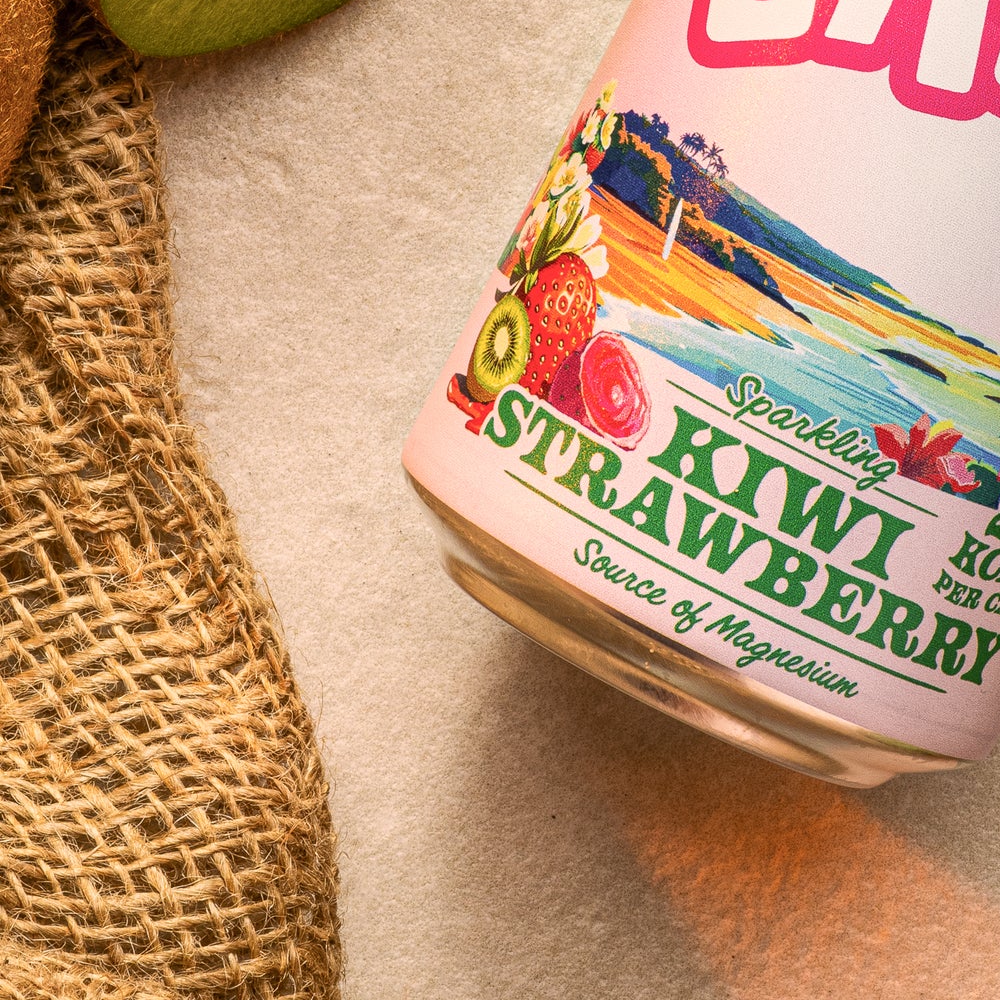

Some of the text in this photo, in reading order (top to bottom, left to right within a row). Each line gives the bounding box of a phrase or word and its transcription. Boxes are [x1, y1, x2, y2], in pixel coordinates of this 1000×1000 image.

[650, 405, 916, 580] KIWI
[726, 376, 898, 487] Sparkling
[574, 538, 859, 699] Source of Magnesium
[932, 568, 983, 610] PER
